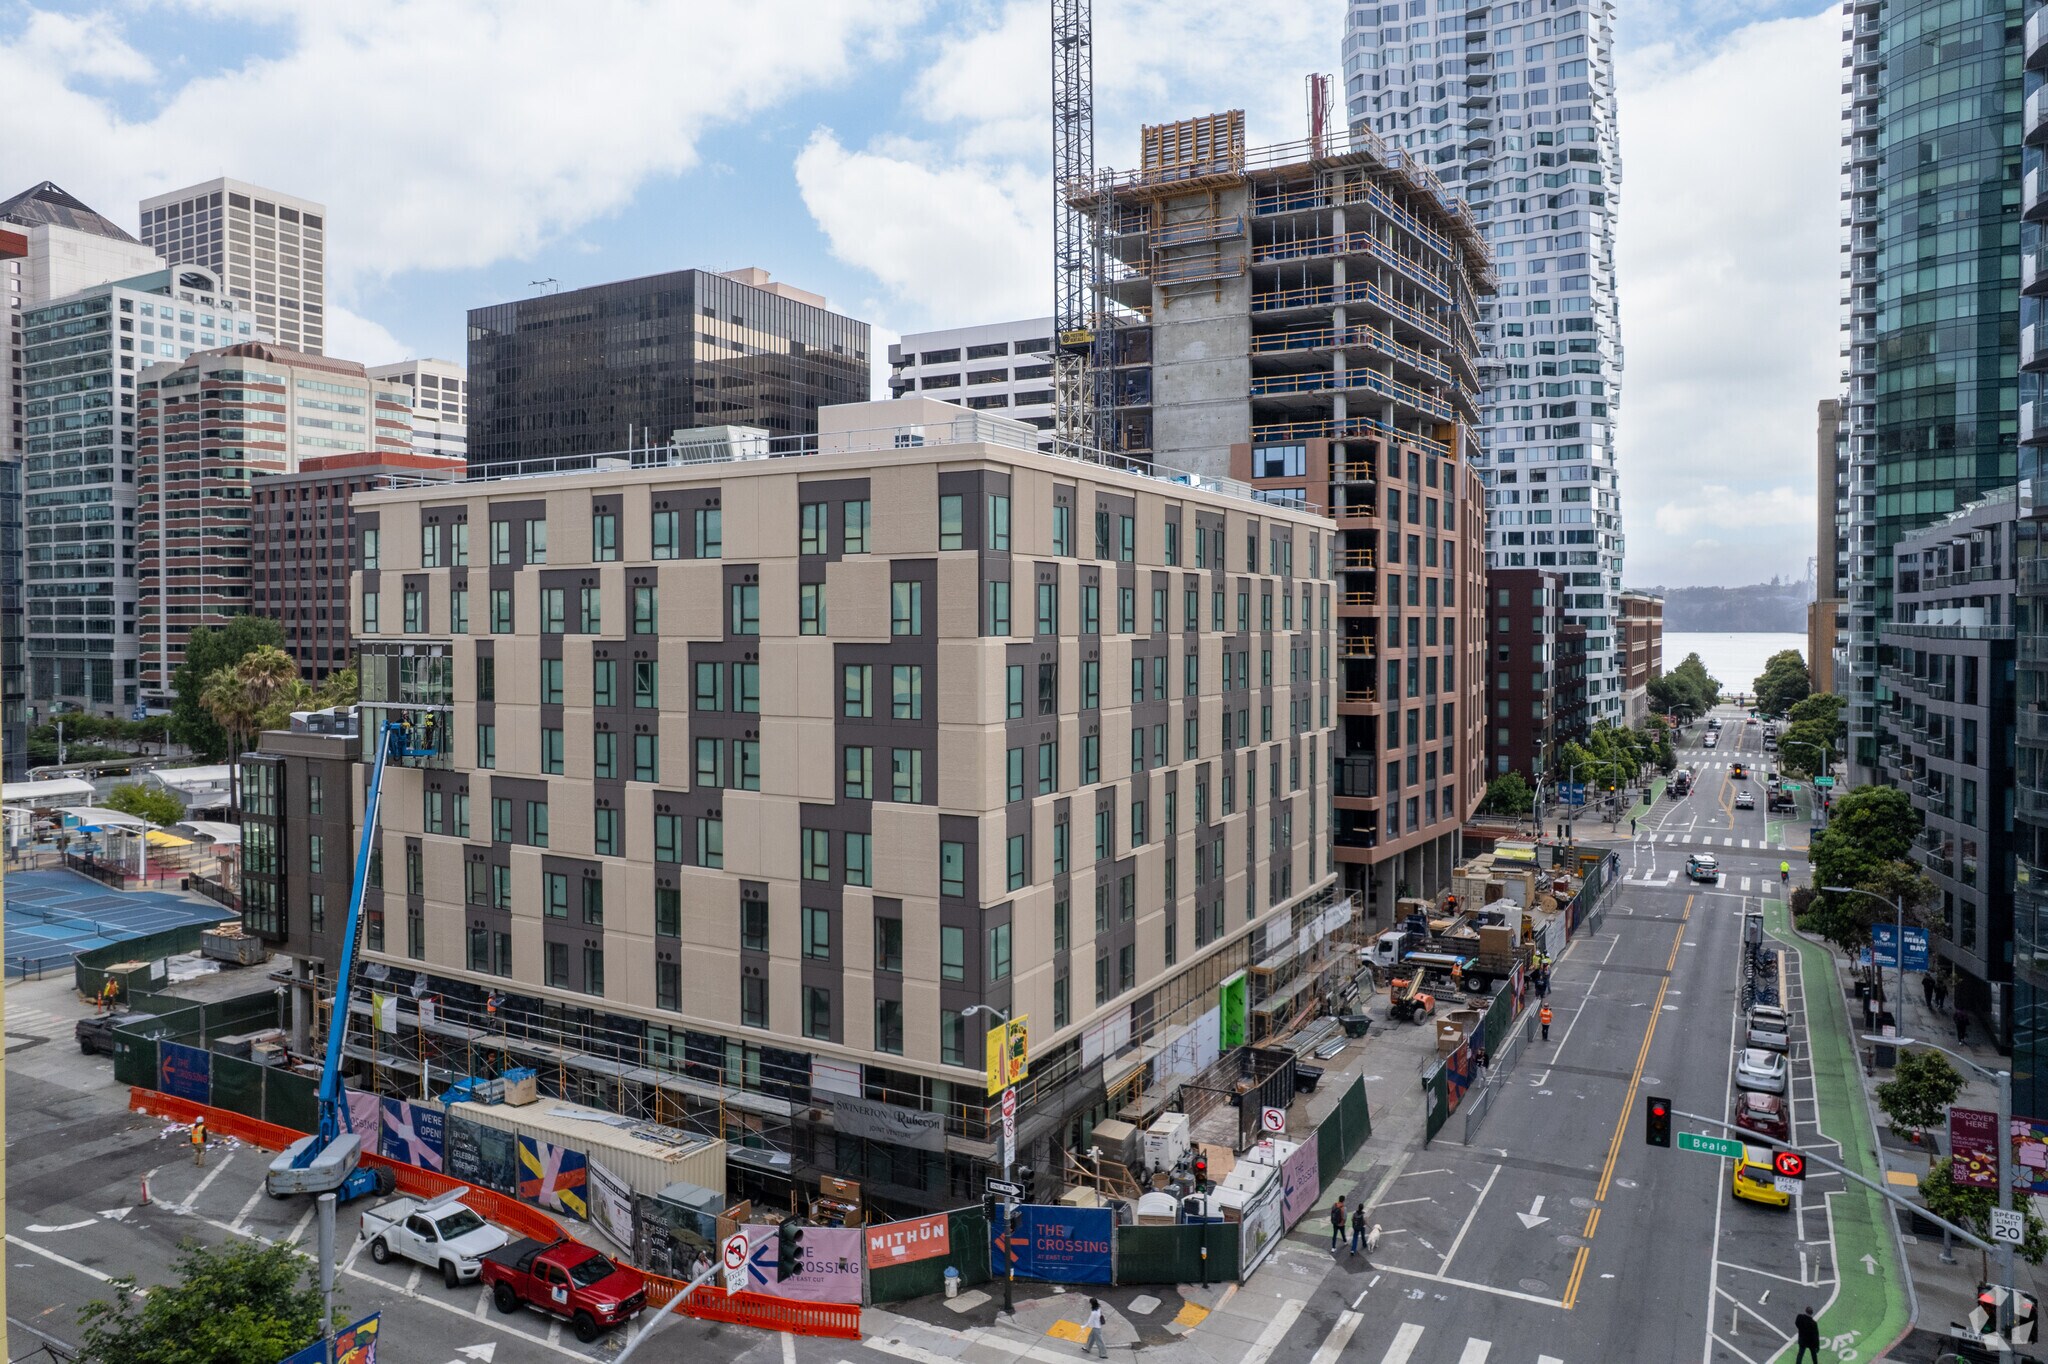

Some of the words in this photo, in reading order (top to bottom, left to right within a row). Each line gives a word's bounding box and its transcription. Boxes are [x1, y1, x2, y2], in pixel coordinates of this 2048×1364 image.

[1874, 939, 1897, 948] Wharton
[1903, 937, 1926, 945] MBA
[836, 1101, 887, 1119] SWINERTON
[421, 1112, 442, 1126] WE'RE
[1950, 1111, 1995, 1122] DISCOVER
[1965, 1120, 1989, 1129] HERE
[421, 1126, 442, 1138] OPEN!
[869, 1125, 885, 1134] JOINT
[886, 1127, 911, 1139] VENTURE
[1693, 1139, 1727, 1152] Beale
[1994, 1211, 2021, 1221] SPEED
[1996, 1218, 2018, 1226] LIMIT
[1036, 1224, 1065, 1237] THE
[1995, 1225, 2020, 1240] 20
[1037, 1238, 1108, 1254] CROSSING
[729, 1267, 746, 1281] EXCEPT
[1962, 1331, 1984, 1341] Beal
